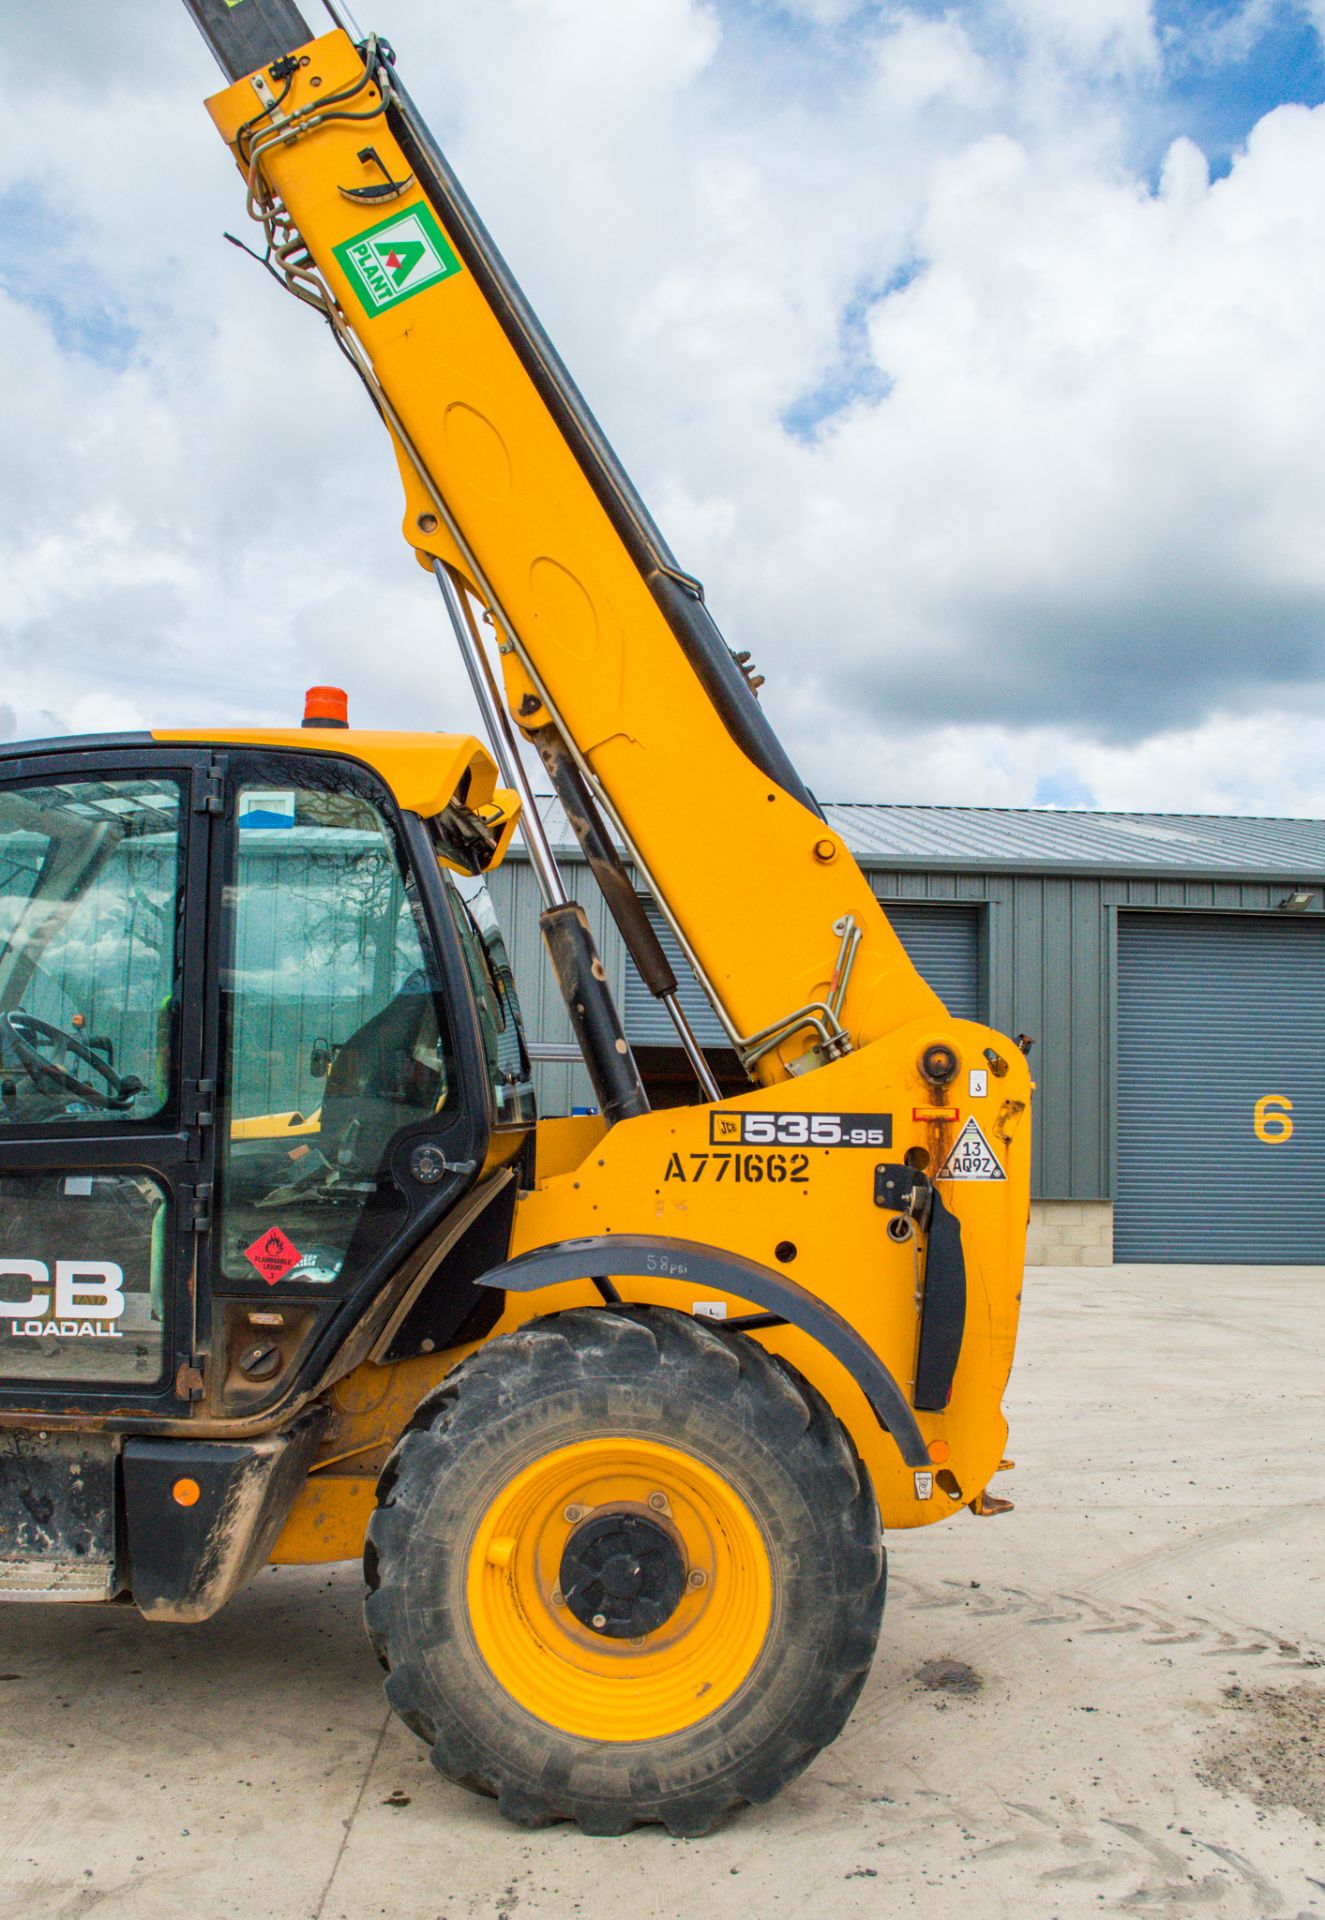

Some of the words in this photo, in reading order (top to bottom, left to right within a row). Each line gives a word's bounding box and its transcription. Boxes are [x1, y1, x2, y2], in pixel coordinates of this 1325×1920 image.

[351, 242, 394, 301] PLANT
[373, 240, 427, 289] A
[719, 1120, 738, 1136] JCB
[744, 1114, 884, 1145] 535-95
[1253, 1094, 1294, 1144] 6
[962, 1141, 982, 1157] 13
[663, 1152, 810, 1183] A771662
[952, 1157, 991, 1173] AQ9Z
[254, 1255, 292, 1266] FLAMMABLE
[11, 1320, 123, 1337] LOADALL
